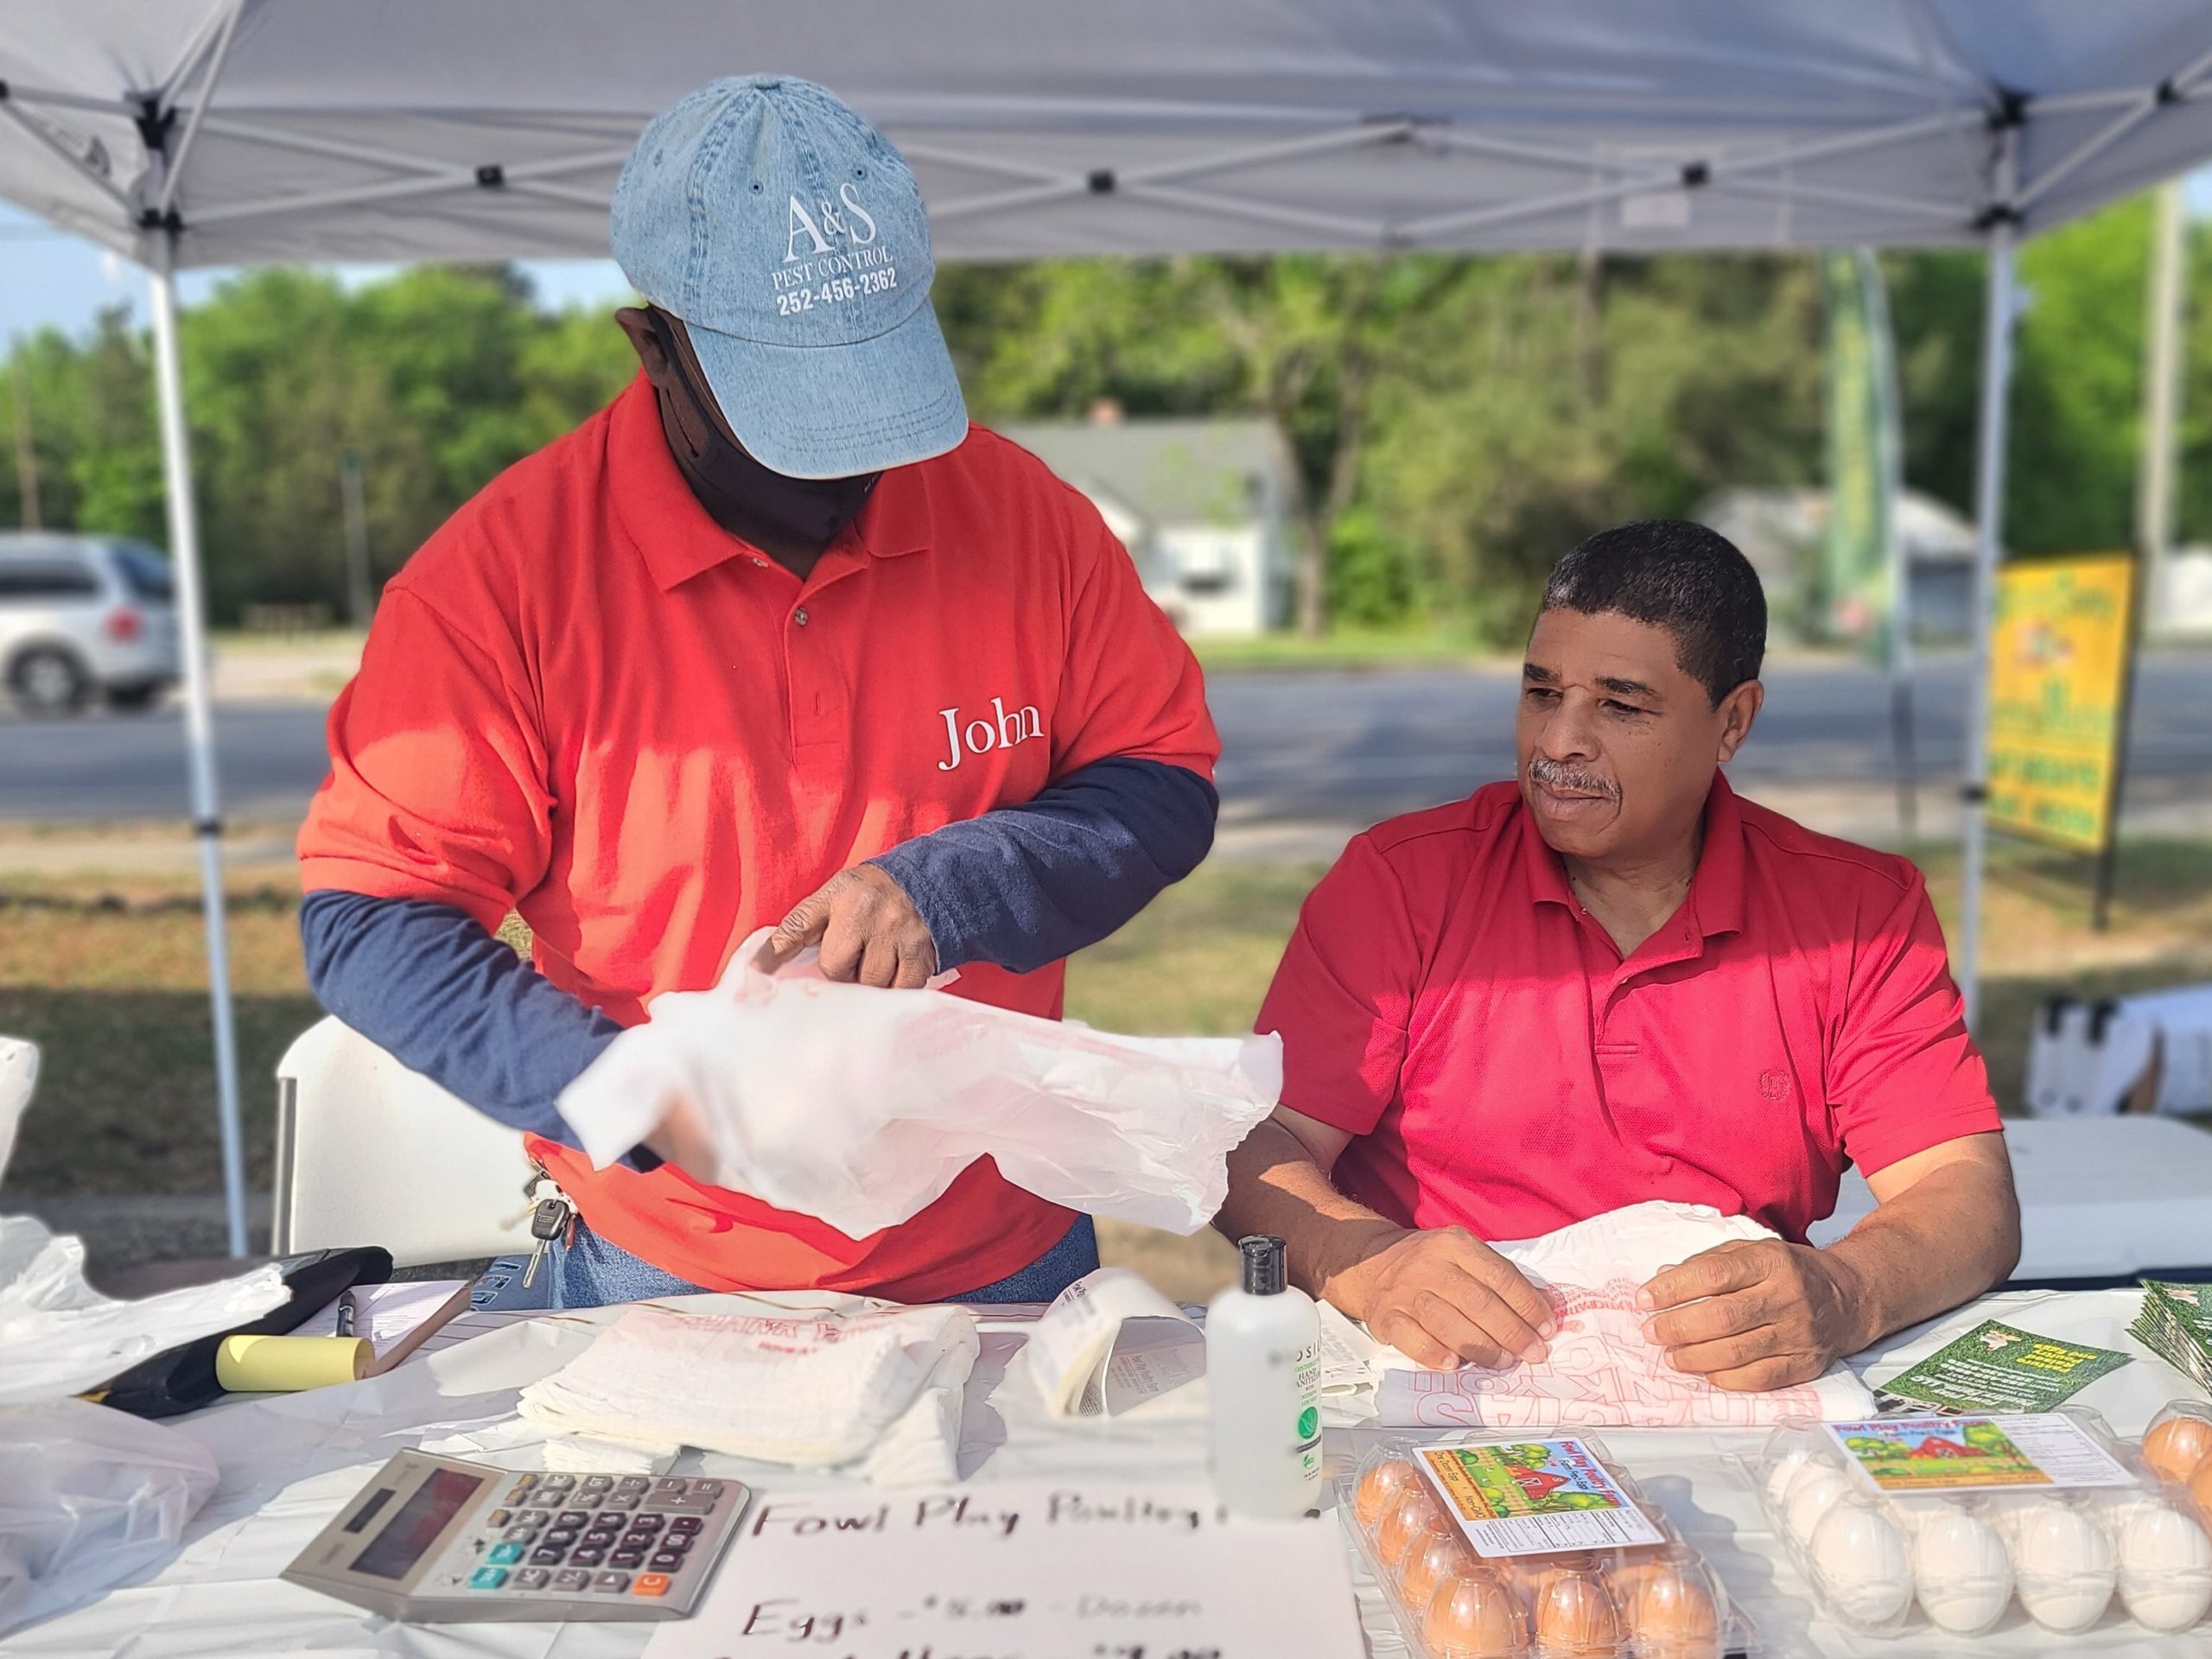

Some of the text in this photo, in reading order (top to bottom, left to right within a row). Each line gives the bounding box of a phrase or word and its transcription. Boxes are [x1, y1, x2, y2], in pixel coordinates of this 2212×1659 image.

[782, 182, 876, 263] A&S
[772, 245, 893, 290] PEST CONTROL
[777, 267, 897, 315] 252-456-2362
[938, 696, 1045, 771] John
[1558, 1441, 1583, 1454] Fowl
[1570, 1455, 1590, 1467] Play
[1581, 1468, 1607, 1488] Poultry
[752, 1503, 888, 1536] Fowl
[914, 1496, 1020, 1536] Play
